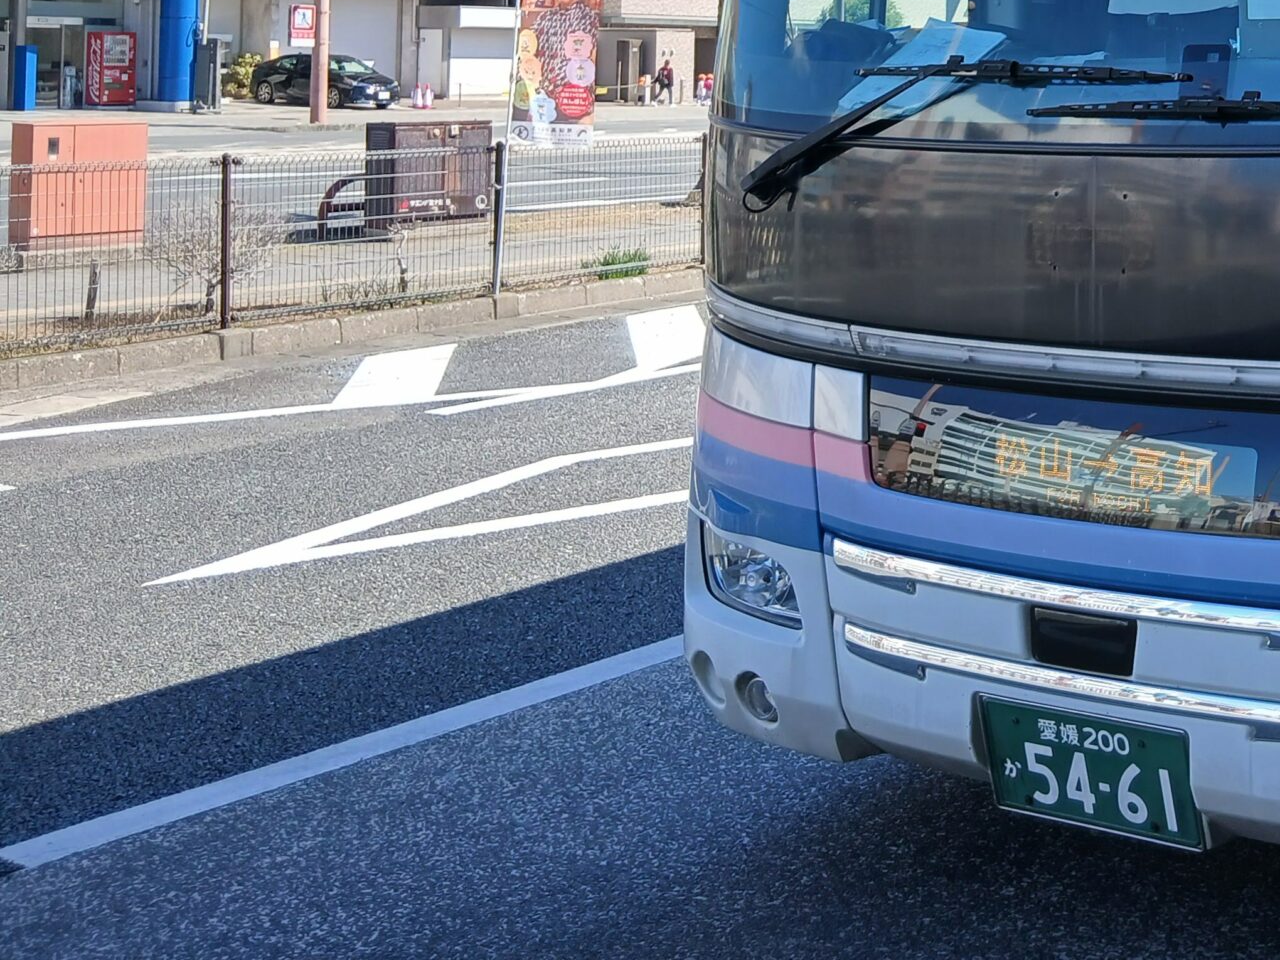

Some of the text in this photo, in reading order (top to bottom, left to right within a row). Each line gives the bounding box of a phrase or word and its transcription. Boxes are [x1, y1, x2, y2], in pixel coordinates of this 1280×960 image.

[1130, 447, 1212, 496] 高知
[1038, 718, 1130, 755] 愛媛 200
[1004, 742, 1178, 832] か 54-61
